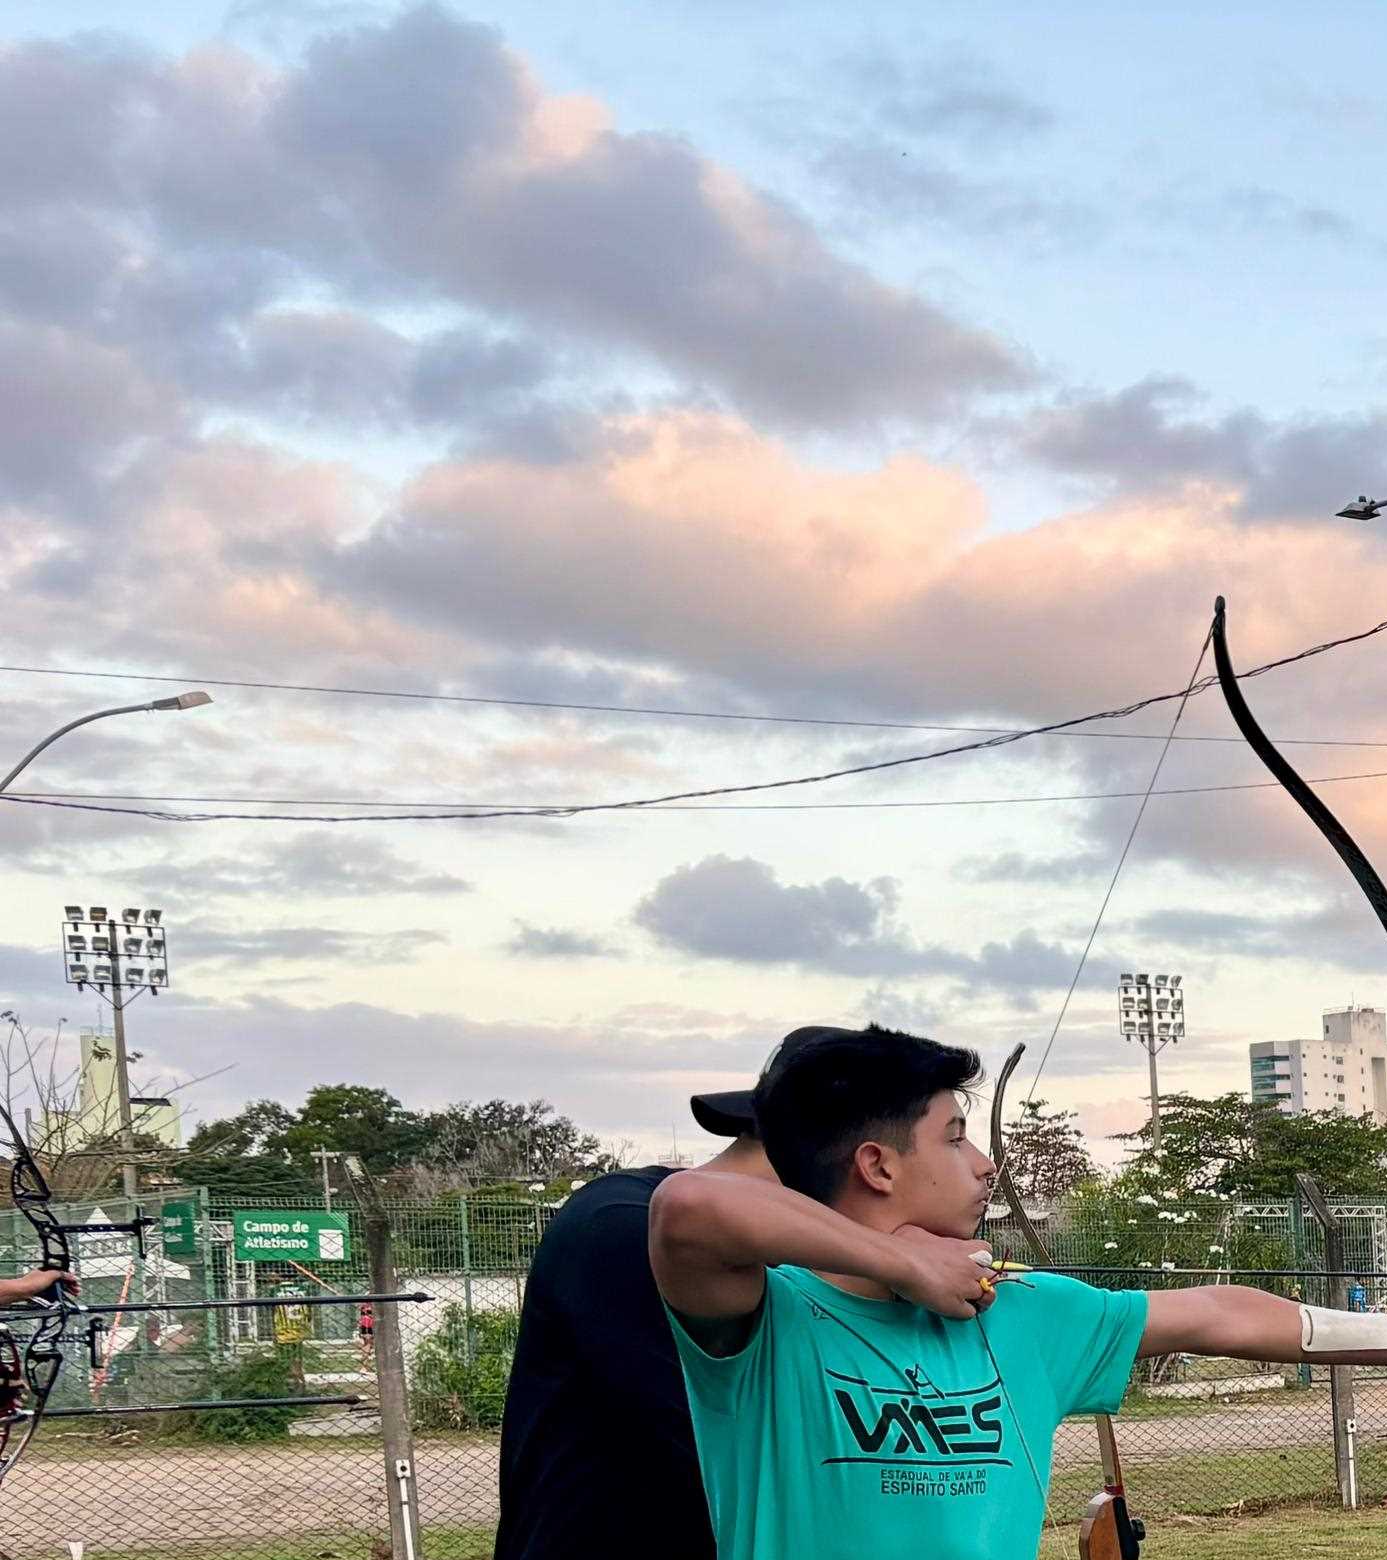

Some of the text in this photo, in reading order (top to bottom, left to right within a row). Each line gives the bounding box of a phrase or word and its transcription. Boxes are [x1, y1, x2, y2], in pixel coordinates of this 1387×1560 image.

[243, 1220, 309, 1235] Campo de
[244, 1236, 309, 1250] Atletismo
[880, 1468, 935, 1481] ESTADUAL
[939, 1471, 951, 1482] DE
[976, 1468, 987, 1480] DO
[949, 1480, 987, 1497] SANTO
